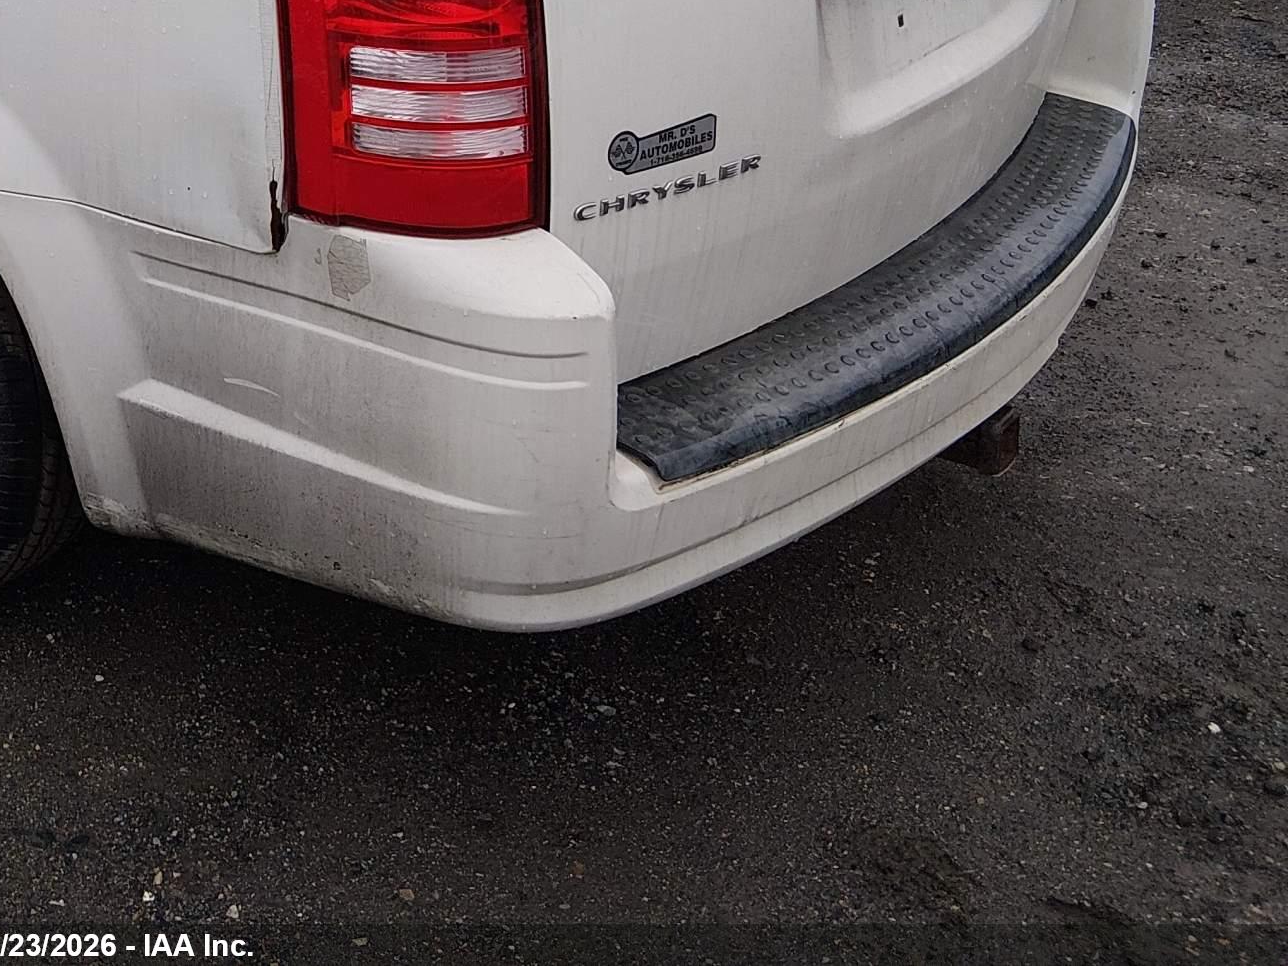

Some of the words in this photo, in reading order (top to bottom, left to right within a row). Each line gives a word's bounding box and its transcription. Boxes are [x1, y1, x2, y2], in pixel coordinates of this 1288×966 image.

[639, 130, 713, 161] AUTOMOBILES
[658, 131, 678, 144] MR.
[680, 124, 696, 137] D'S
[573, 153, 762, 222] CHRYSLER
